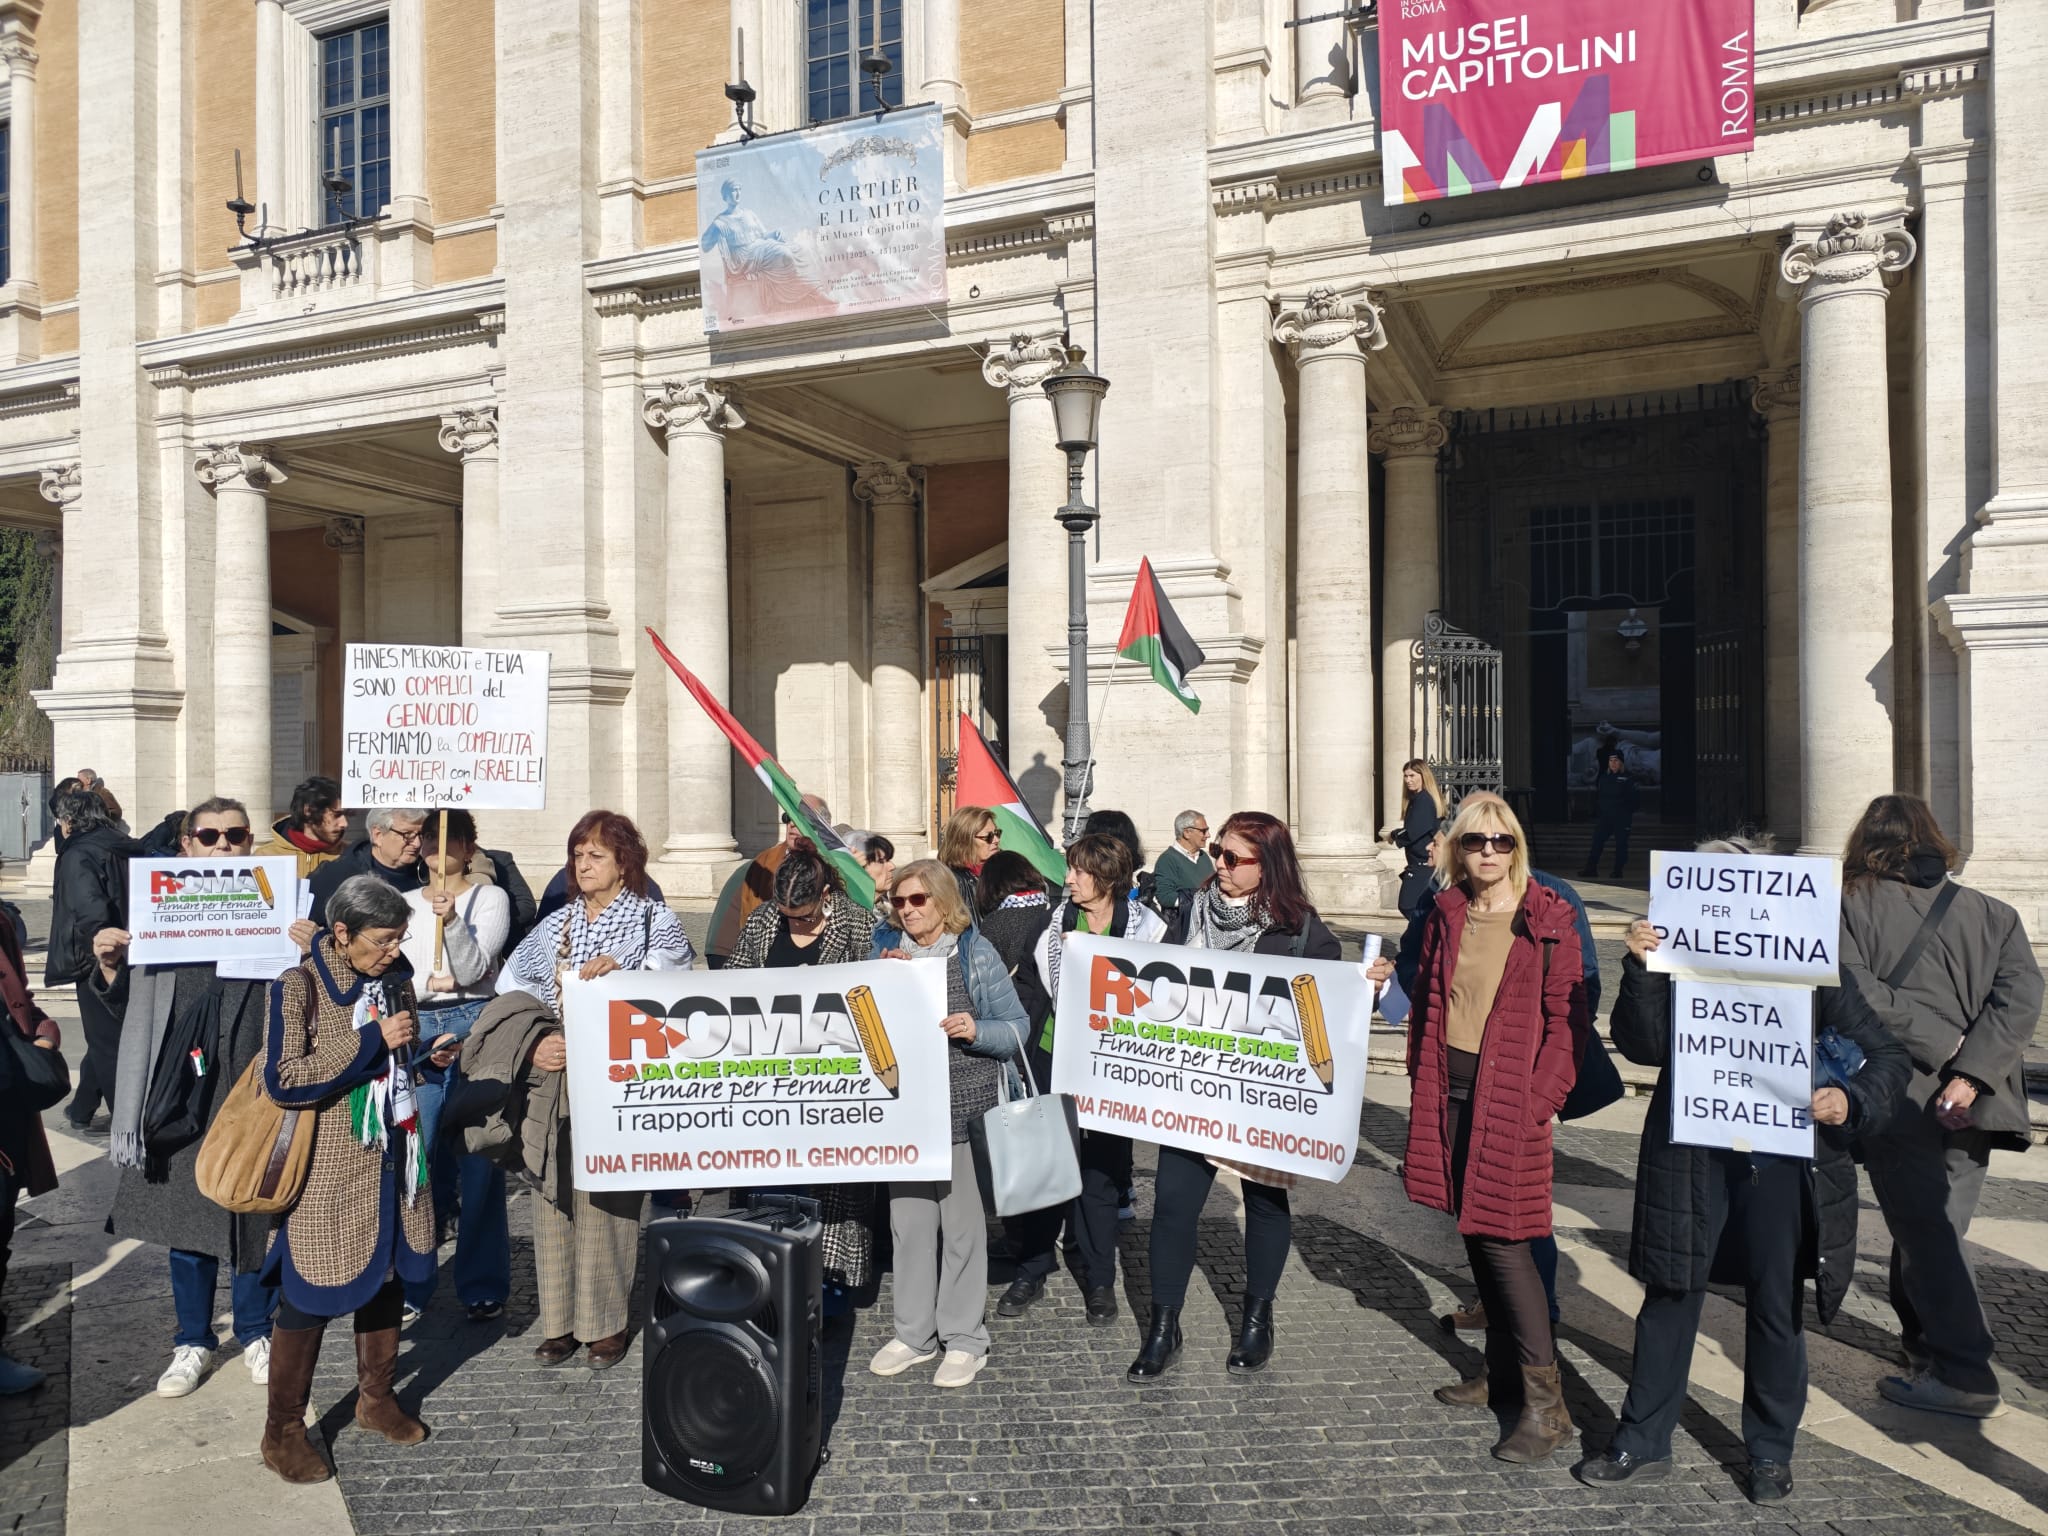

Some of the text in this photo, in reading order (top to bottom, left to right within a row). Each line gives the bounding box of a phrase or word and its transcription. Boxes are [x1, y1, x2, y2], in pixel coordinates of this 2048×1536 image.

[1401, 1, 1446, 20] ROMA
[1402, 15, 1528, 68] MUSEI
[1402, 30, 1636, 100] CAPITOLINI
[1721, 30, 1749, 138] ROMA
[818, 176, 918, 206] CARTIER
[820, 199, 920, 227] E IL MITO
[833, 227, 863, 240] Musei
[867, 219, 920, 237] Capitolini
[927, 239, 944, 300] ROMA
[401, 648, 473, 670] MEKOROT
[474, 660, 483, 670] e
[485, 652, 524, 674] TEVA
[353, 675, 506, 698] SONO COMPLICI del
[386, 702, 479, 728] GENOCIDIO
[348, 731, 535, 756] FERMIAMO la COMPLICITÀ
[347, 760, 362, 778] di
[369, 760, 445, 780] GUALTIERI
[450, 767, 470, 780] con
[362, 783, 464, 805] Potere al Popolo
[150, 868, 259, 895] ROMA
[1666, 865, 1818, 899] GIUSTIZIA
[157, 900, 263, 911] Firmare per Fermare
[160, 911, 204, 924] rapporti
[207, 912, 229, 921] con
[231, 909, 268, 920] Israele
[1701, 904, 1770, 922] PER LA
[139, 927, 282, 940] UNA FIRMA CONTRO IL GENOCIDIO
[1652, 925, 1830, 964] PALESTINA
[1089, 954, 1301, 1042] ROMA
[1691, 997, 1783, 1028] BASTA
[608, 992, 863, 1061] ROMA
[1088, 1013, 1299, 1063] SA DA CHE PARTE STARE
[1099, 1033, 1307, 1084] Firmare per Fermare
[1678, 1032, 1809, 1069] IMPUNITÀ
[608, 1057, 862, 1083] SA DA CHE PARTE STARE
[1713, 1069, 1754, 1089] PER
[624, 1076, 871, 1104] Firmare per Fermare
[1092, 1056, 1318, 1116] i rapporti con Israele
[617, 1101, 884, 1134] i rapporti con Israele
[1684, 1094, 1808, 1130] ISRAELE
[1073, 1094, 1346, 1166] NA FIRMA CONTRO IL GENOCIDIO
[585, 1144, 920, 1175] UNA FIRMA CONTRO IL GENOCIDIO
